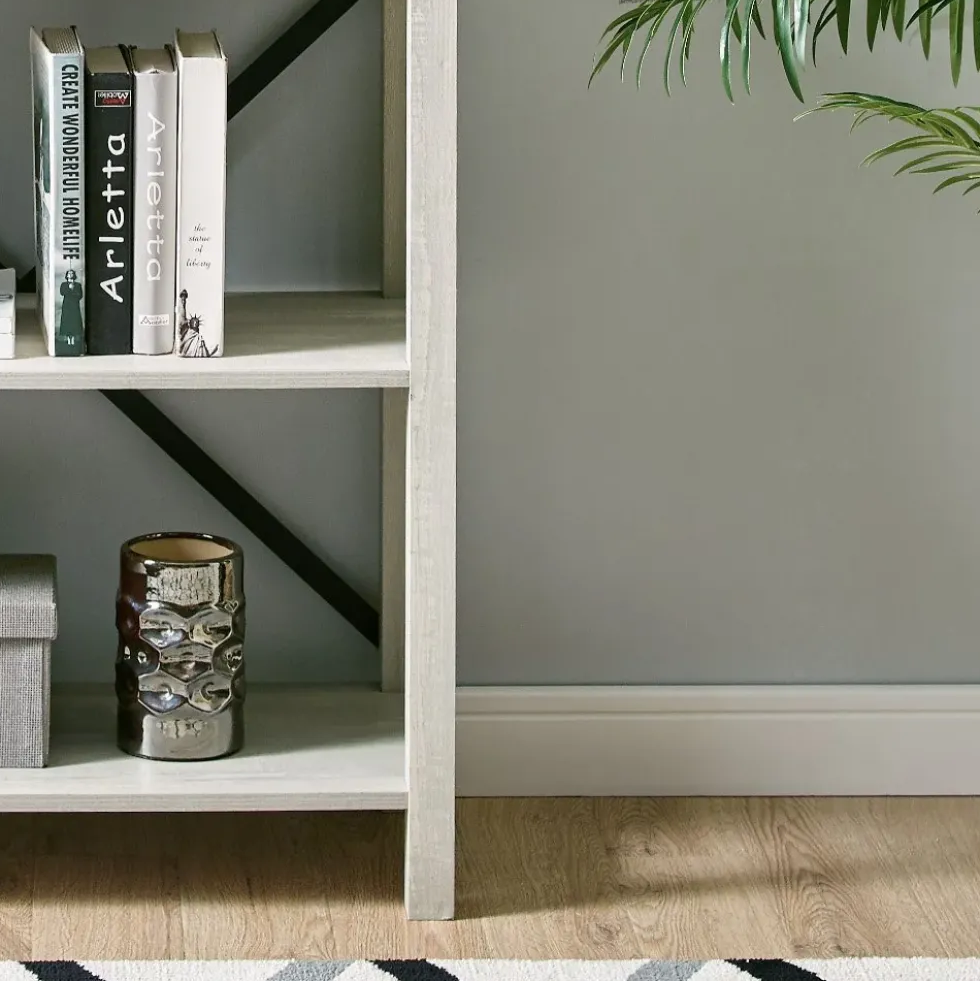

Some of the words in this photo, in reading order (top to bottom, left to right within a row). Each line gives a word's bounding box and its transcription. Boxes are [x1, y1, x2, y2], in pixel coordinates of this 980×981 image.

[62, 64, 79, 110] CREATE
[62, 113, 80, 194] WONDERFUL
[62, 197, 80, 260] HOMELIFE
[98, 133, 126, 303] Arletta
[147, 111, 166, 282] Arletta
